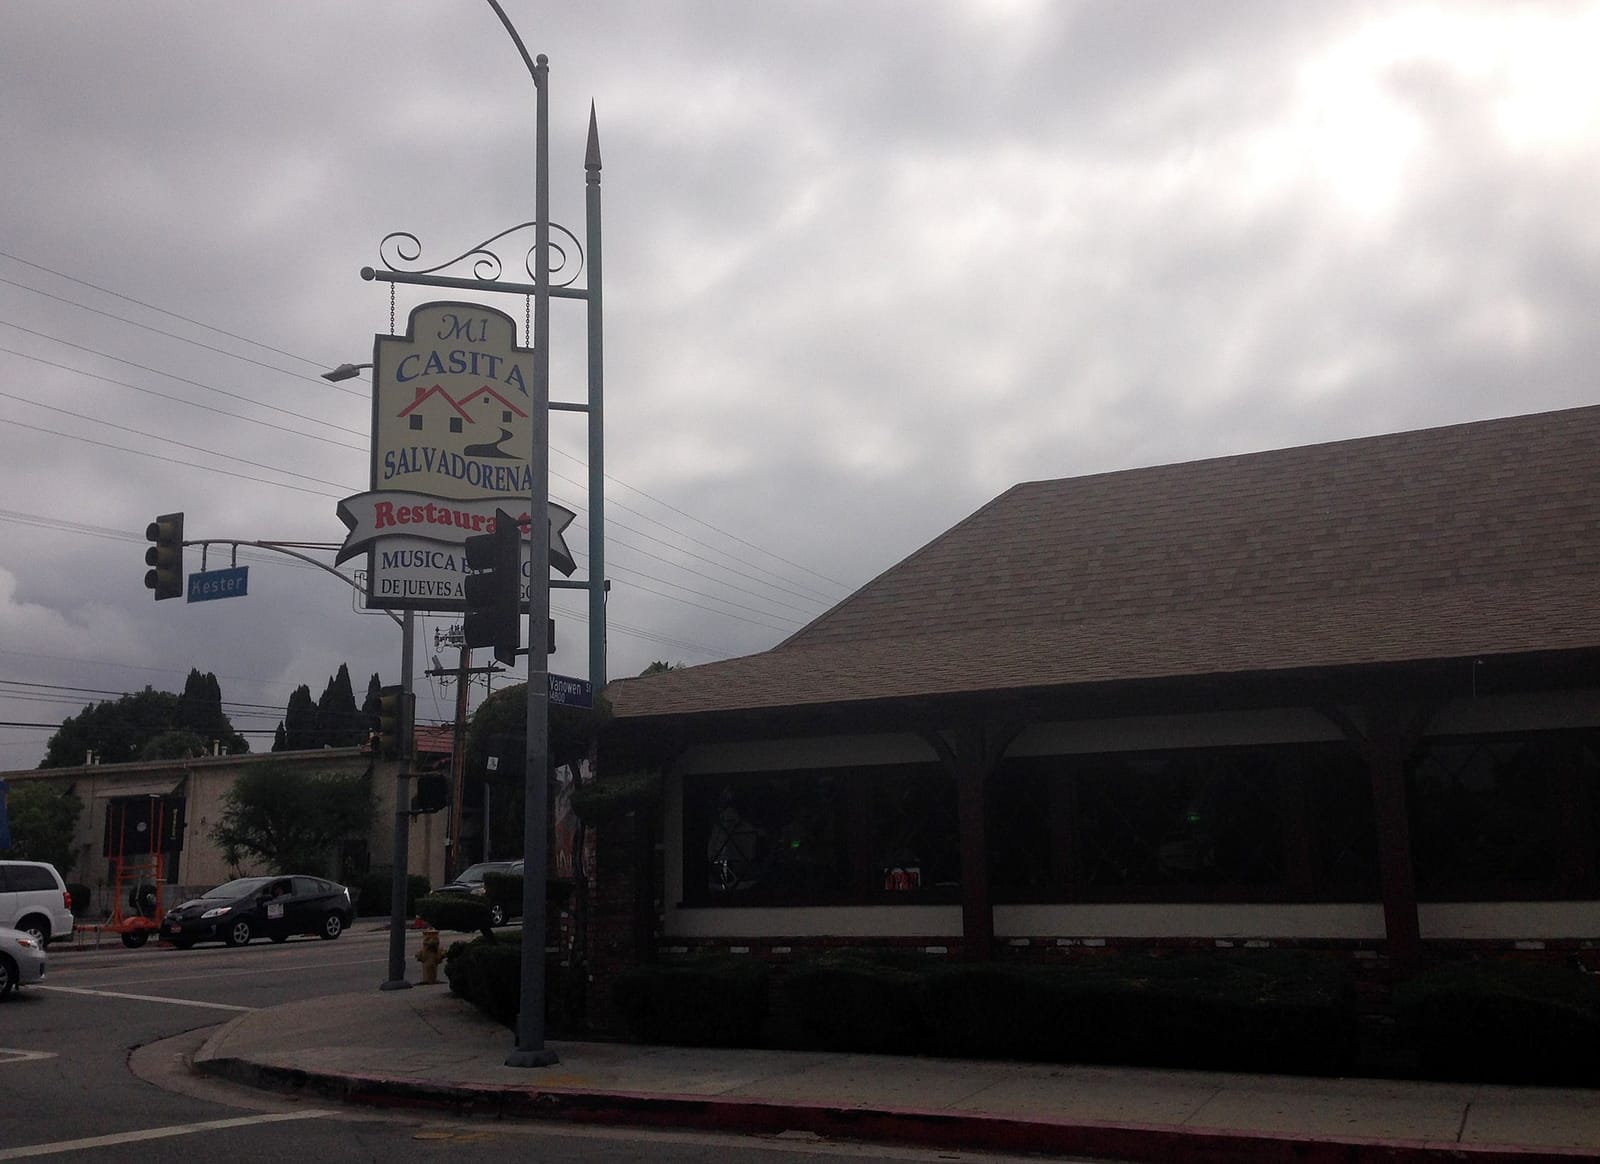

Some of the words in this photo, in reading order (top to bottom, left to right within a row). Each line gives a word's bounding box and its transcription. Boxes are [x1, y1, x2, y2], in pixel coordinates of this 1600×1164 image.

[437, 313, 489, 343] MI
[396, 350, 529, 398] CASITA
[384, 446, 533, 492] SALVADORENA
[382, 550, 457, 572] MUSICA
[191, 576, 242, 595] Kester
[382, 579, 401, 595] DE
[402, 579, 451, 597] JUEVES
[454, 581, 465, 597] A
